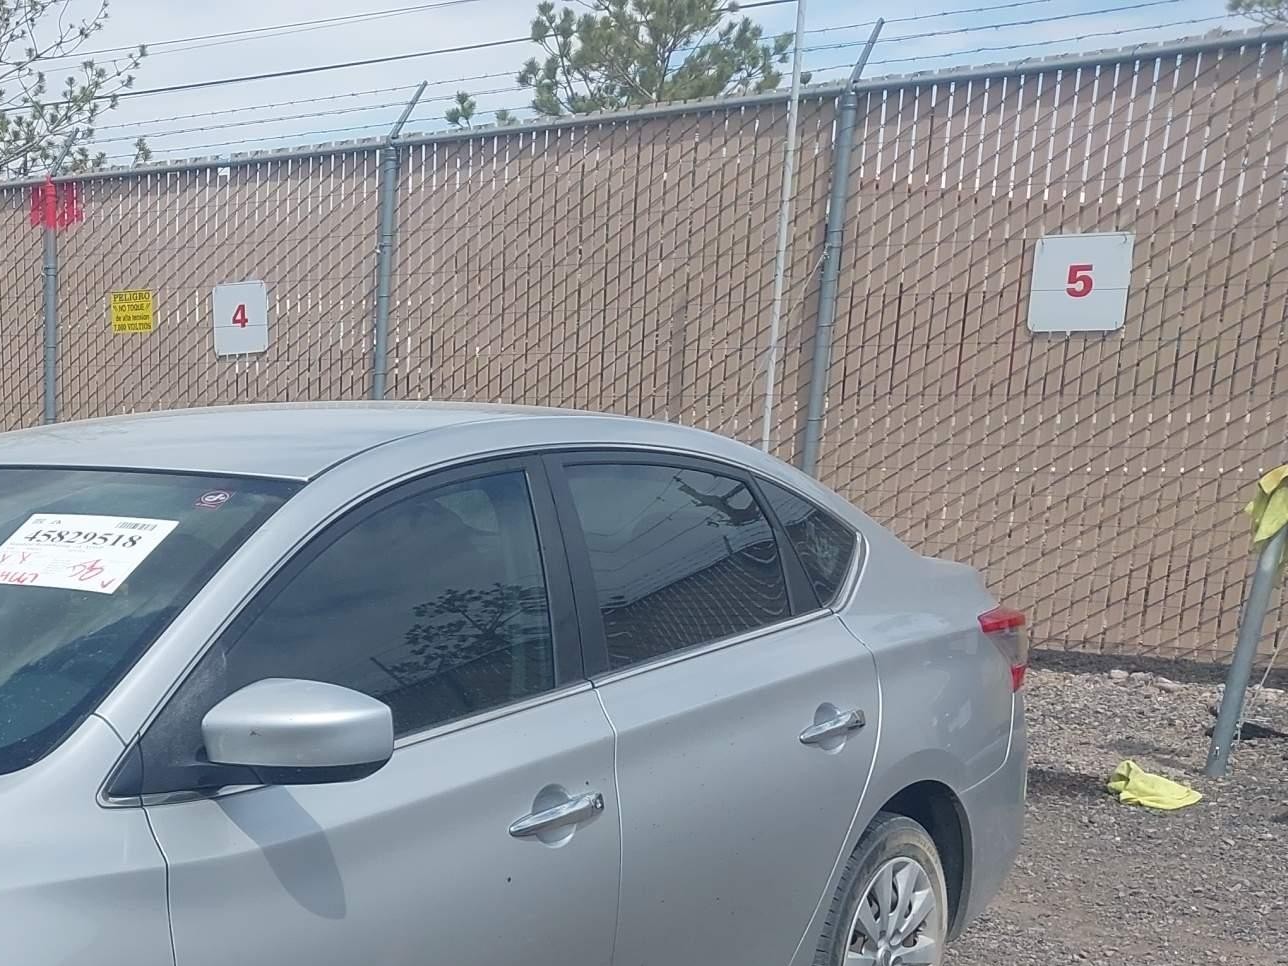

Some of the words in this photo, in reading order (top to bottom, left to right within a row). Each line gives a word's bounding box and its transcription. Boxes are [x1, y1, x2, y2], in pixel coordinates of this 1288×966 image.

[1066, 264, 1093, 298] 5
[113, 292, 150, 301] PELIGRO
[118, 304, 126, 312] NO
[127, 303, 144, 311] TOQUE
[231, 303, 249, 329] 4
[127, 322, 151, 330] VOLTIOS
[24, 529, 143, 548] 45829518
